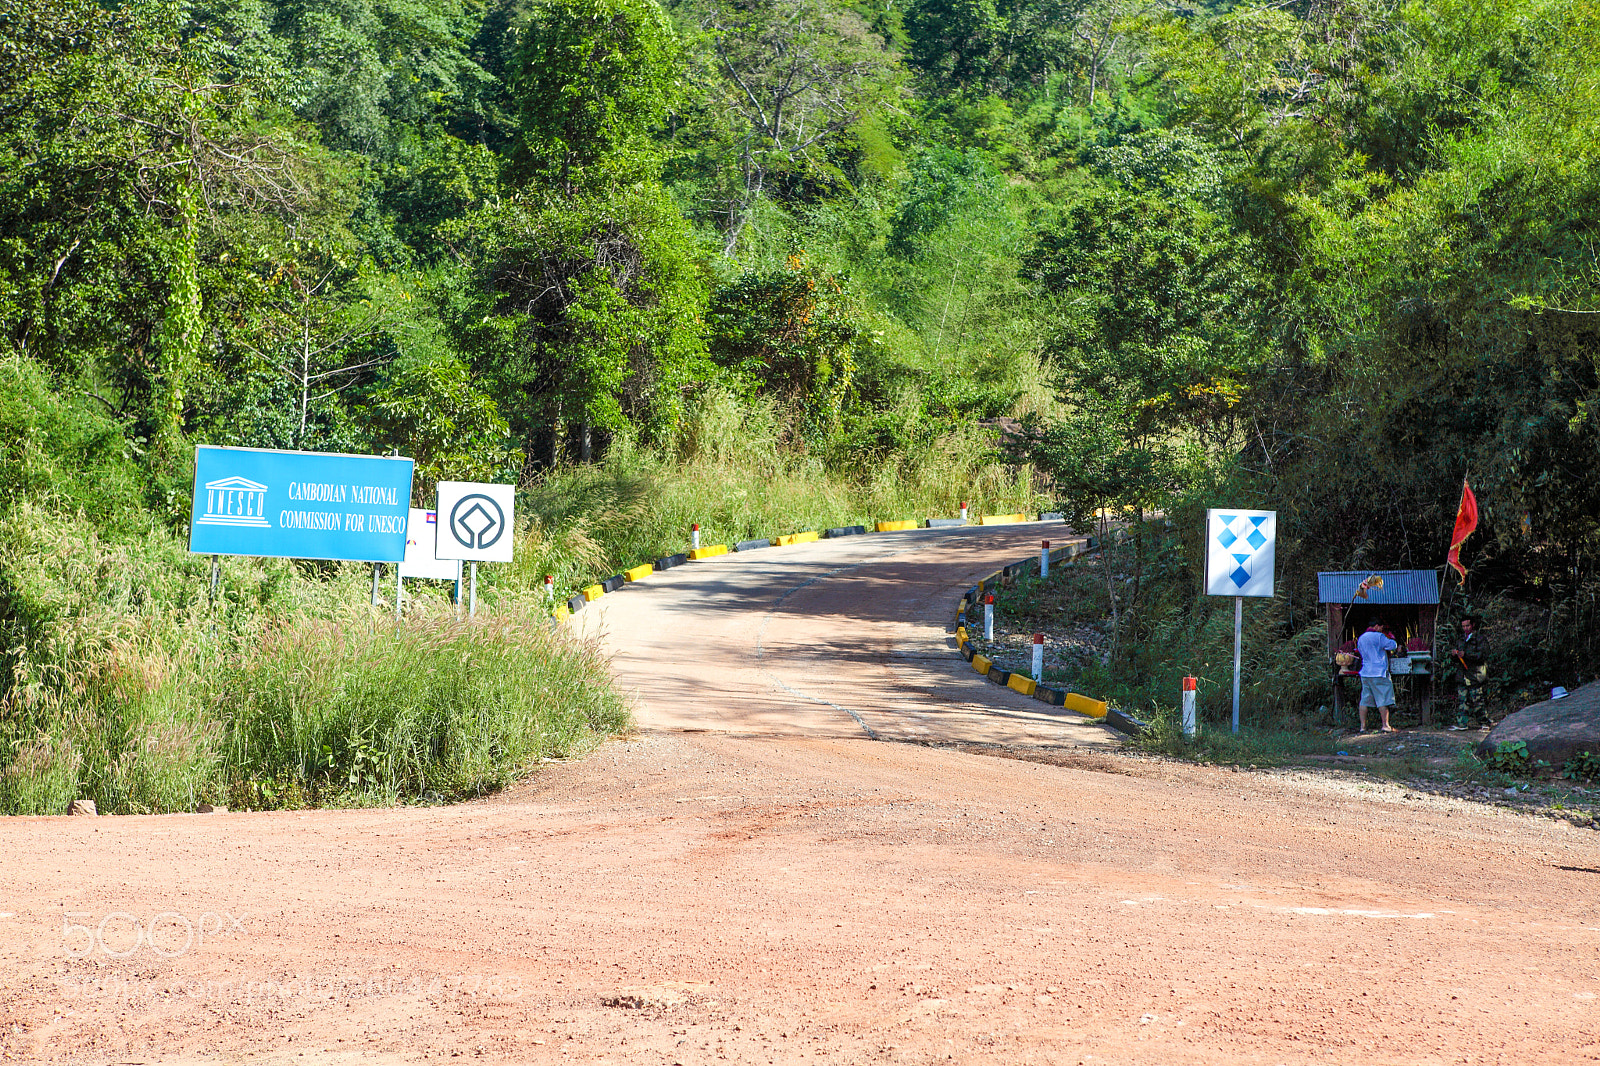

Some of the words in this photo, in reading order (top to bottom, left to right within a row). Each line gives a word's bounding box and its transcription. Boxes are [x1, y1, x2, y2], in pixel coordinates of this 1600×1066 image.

[207, 489, 264, 516] UNESCO
[289, 482, 347, 503] CAMBODIAN
[351, 485, 399, 506] NATIONAL
[279, 509, 341, 531] COMMISSION
[345, 513, 364, 532] FOR
[368, 514, 406, 535] UNESCO
